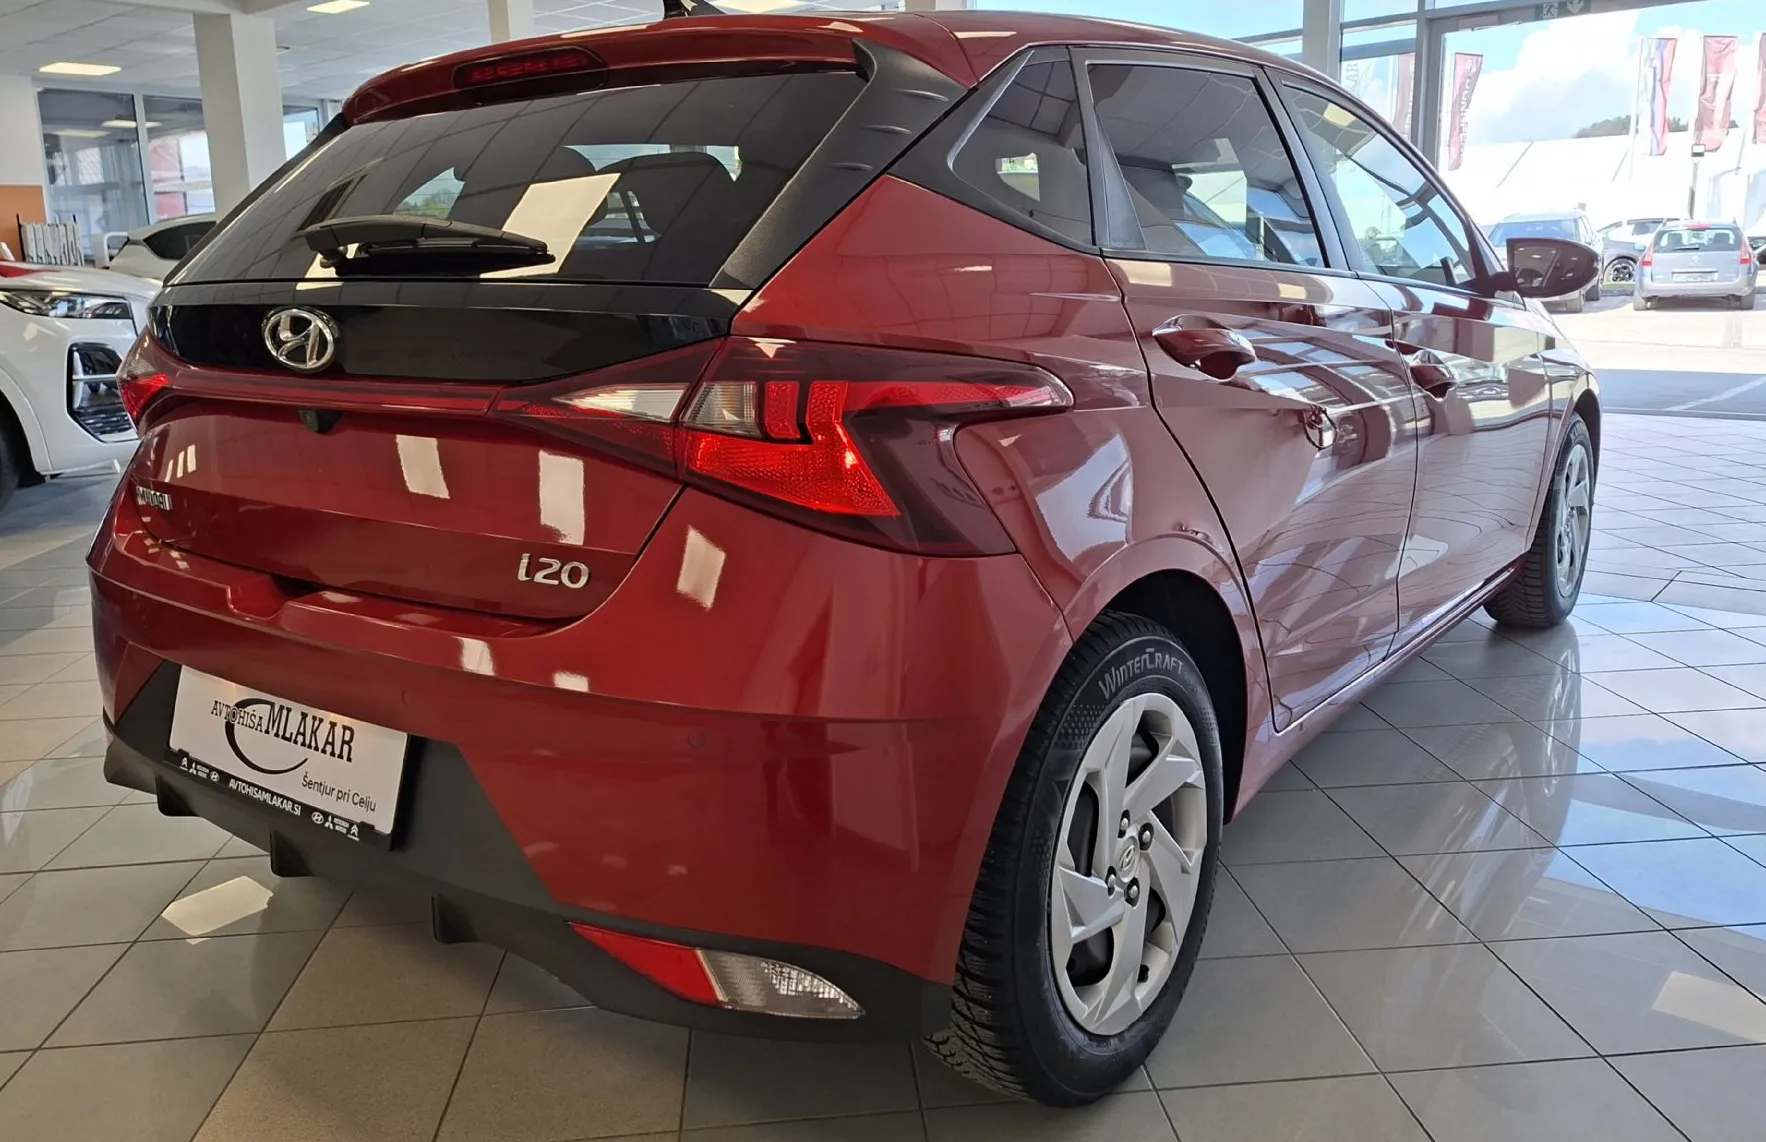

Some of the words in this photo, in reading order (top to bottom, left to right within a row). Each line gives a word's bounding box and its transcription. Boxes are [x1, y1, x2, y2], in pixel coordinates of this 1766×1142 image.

[211, 700, 263, 733] AVTOHIŠA
[264, 702, 354, 762] MLAKAR
[229, 778, 301, 816] AVTOHISAMLAKAR.SI
[302, 771, 335, 797] Šentjur
[336, 789, 351, 802] pri
[352, 792, 376, 812] Celju
